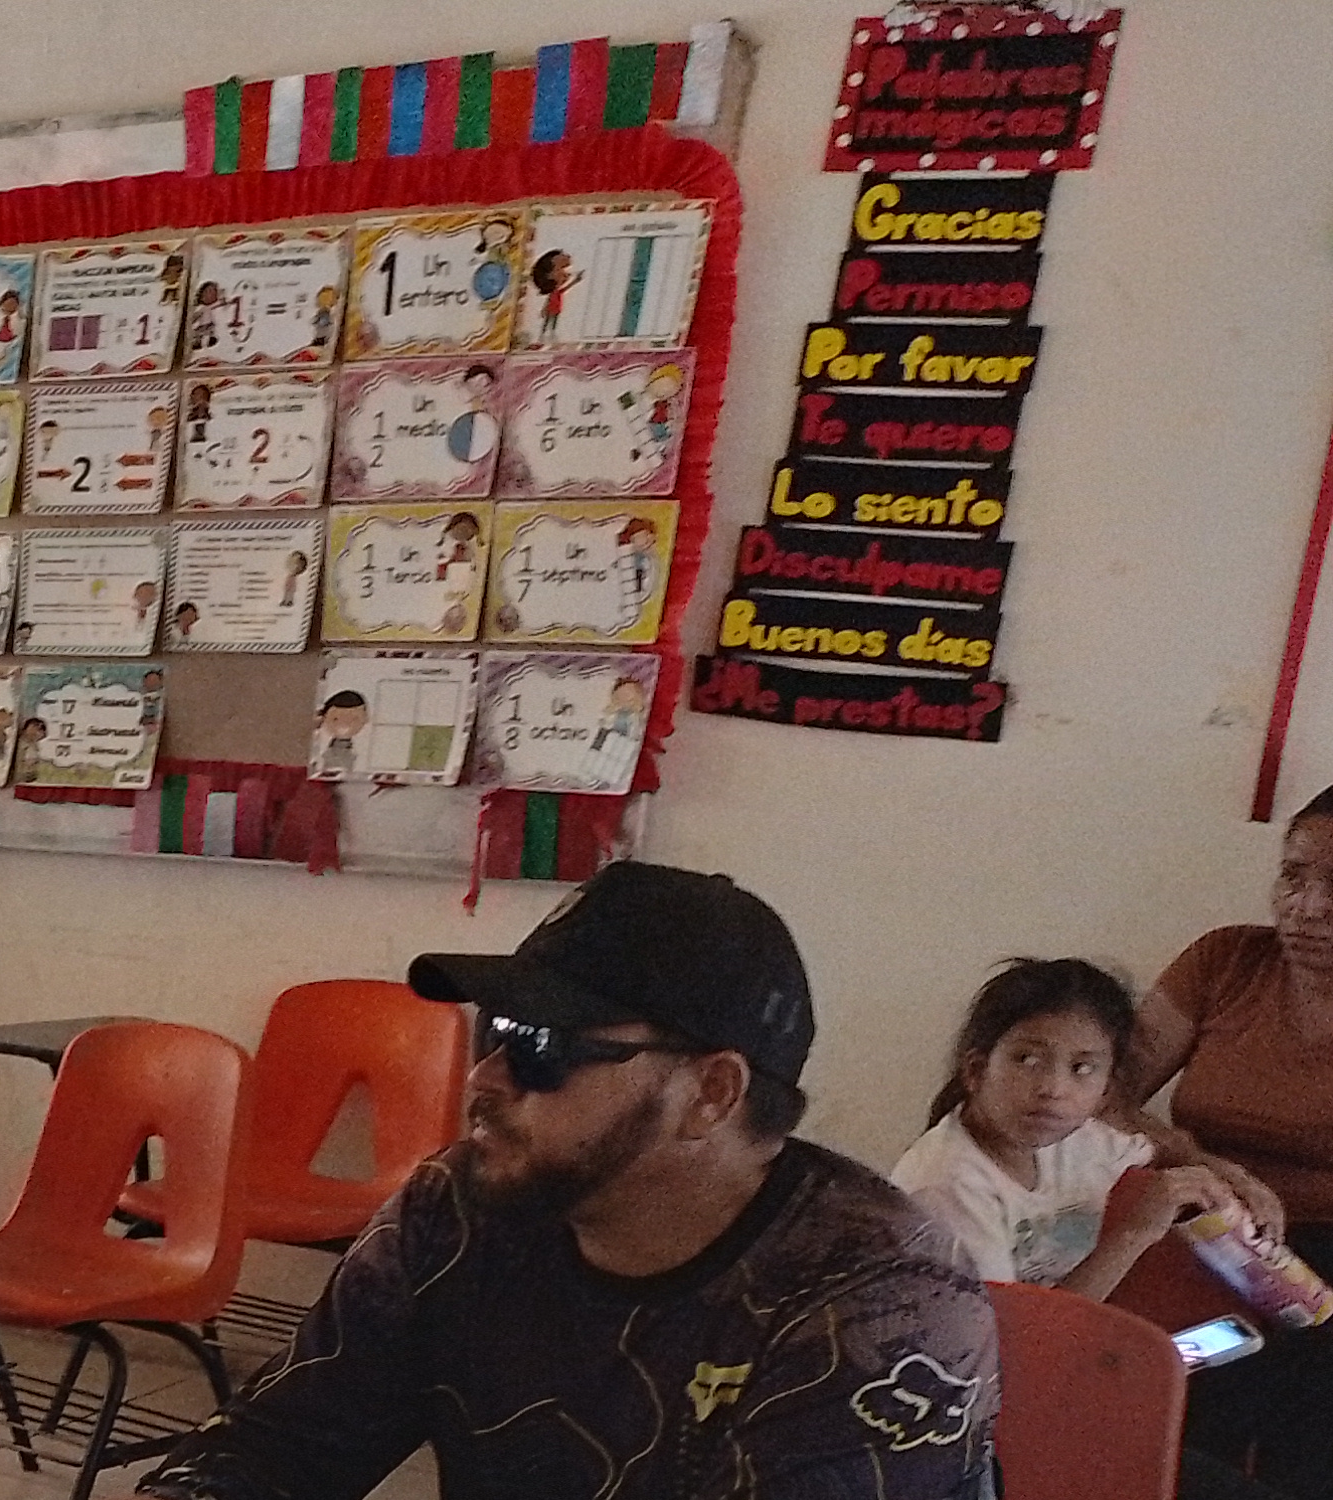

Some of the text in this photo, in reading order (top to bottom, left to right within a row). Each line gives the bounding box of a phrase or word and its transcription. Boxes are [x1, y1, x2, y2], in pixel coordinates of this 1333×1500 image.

[864, 45, 1084, 101] Palabras
[855, 182, 1043, 241] Gracias
[424, 253, 451, 277] Un
[380, 251, 397, 316] 1
[399, 285, 469, 308] entero
[838, 259, 1032, 311] Permiso
[803, 327, 1035, 384] Por favor
[545, 393, 559, 422] 1
[373, 411, 386, 439] 1
[800, 394, 1014, 459] Te quiero
[249, 427, 270, 463] 2
[540, 428, 556, 453] 6
[369, 444, 384, 468] 2
[71, 456, 92, 493] 2
[771, 467, 1004, 527] Lo siento
[362, 543, 377, 570] 1
[519, 545, 534, 572] 1
[360, 575, 374, 599] 3
[517, 578, 532, 603] 7
[719, 600, 994, 667] Buenos días
[508, 694, 522, 721] 1
[795, 682, 1006, 740] prestas?
[504, 726, 519, 751] 8
